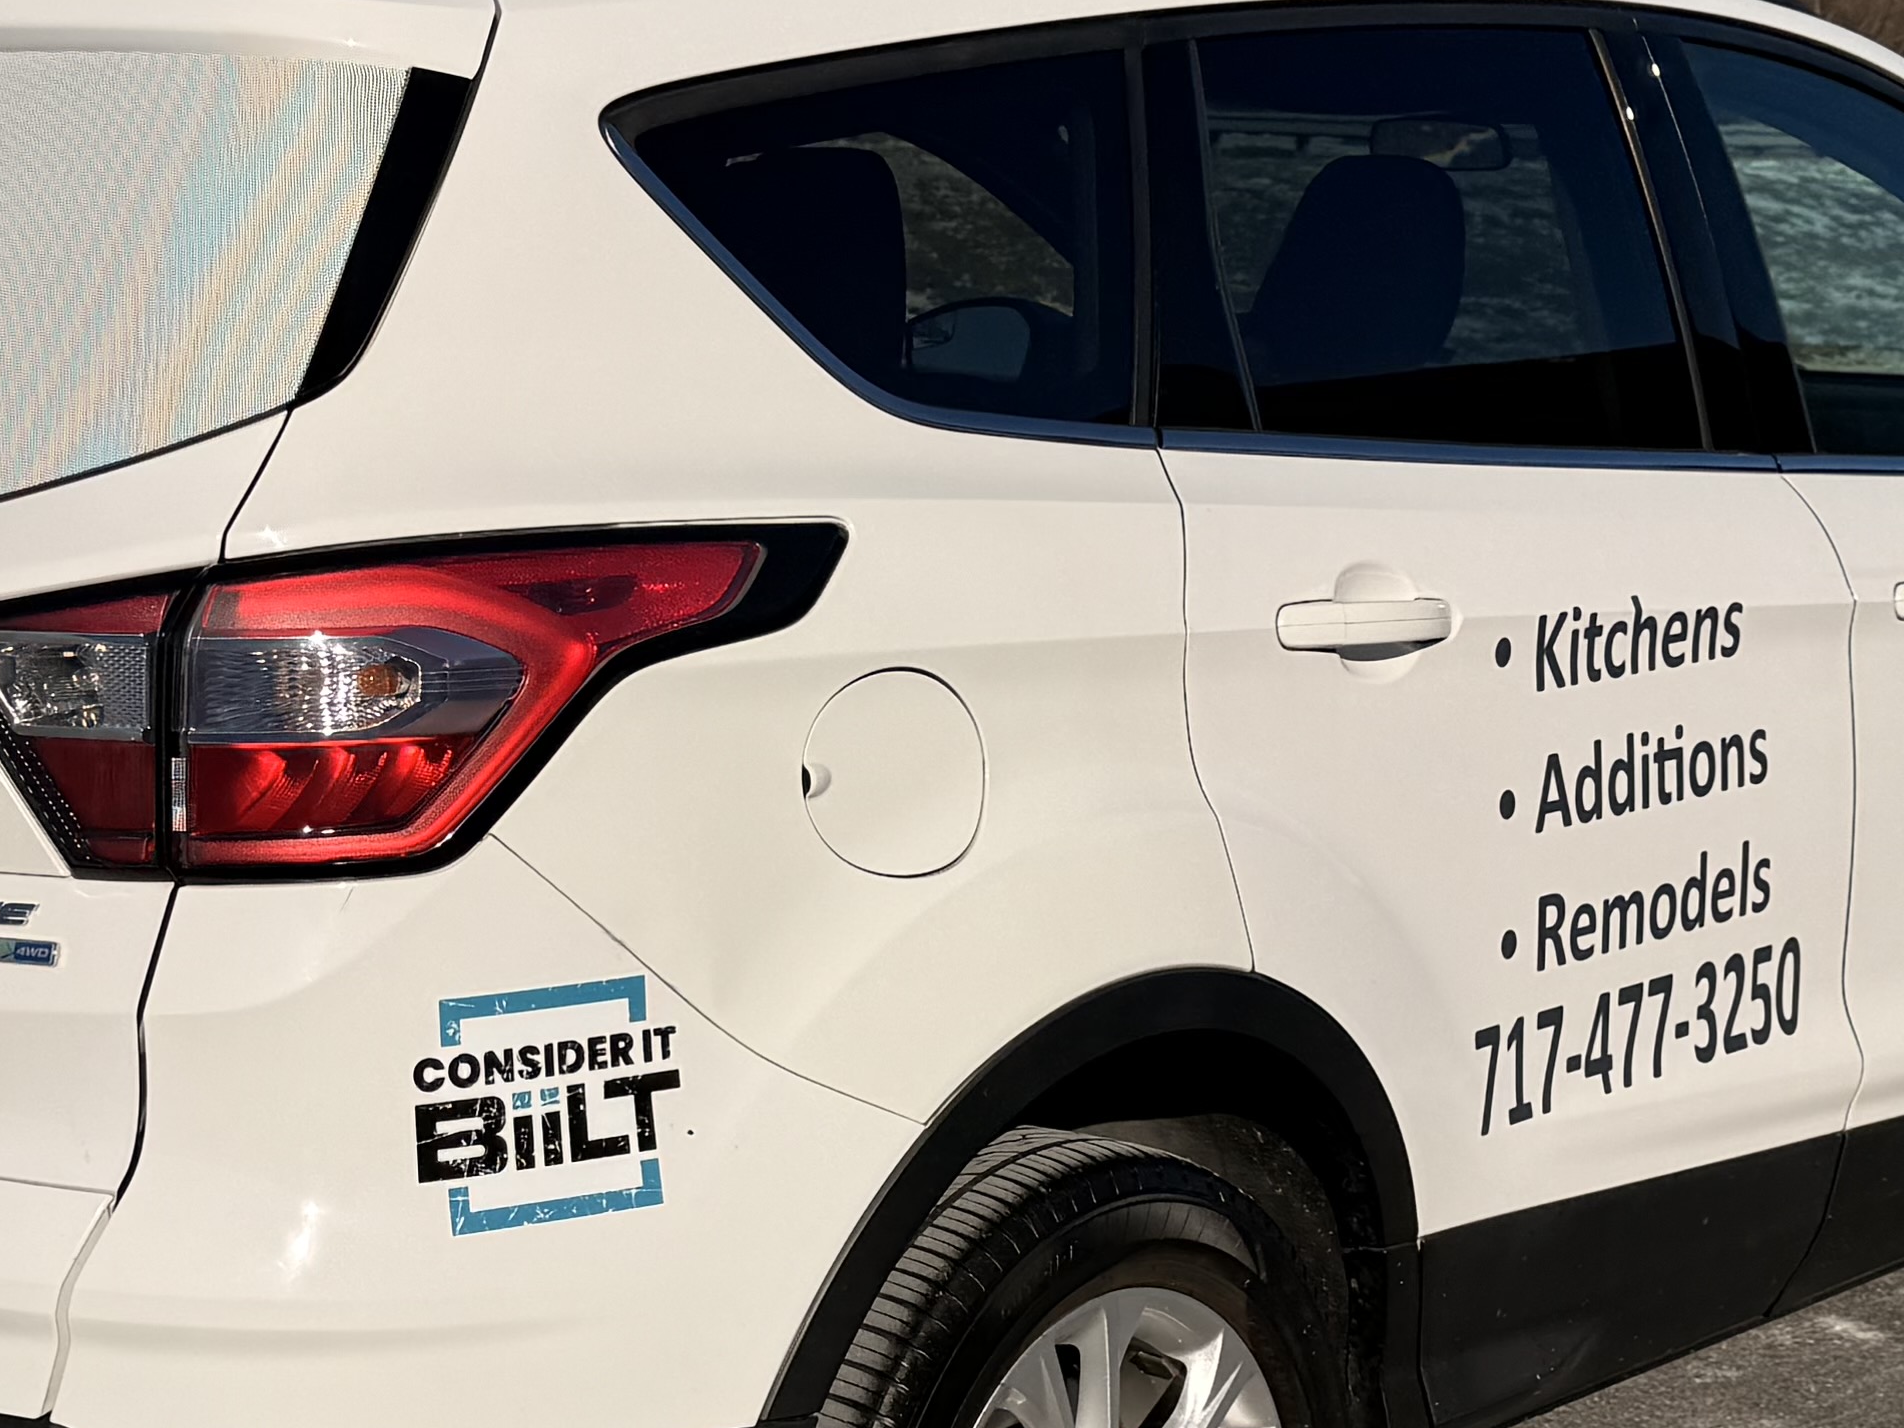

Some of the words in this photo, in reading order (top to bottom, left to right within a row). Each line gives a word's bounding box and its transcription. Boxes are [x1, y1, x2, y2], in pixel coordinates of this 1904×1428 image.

[1536, 595, 1744, 693] Kitchens
[1535, 724, 1768, 834] Additions
[16, 946, 49, 958] 4WD
[1536, 839, 1773, 972] Remodels
[412, 1032, 631, 1093] CONSIDER
[641, 1025, 677, 1064] IT
[1474, 936, 1801, 1137] 717-477-3250
